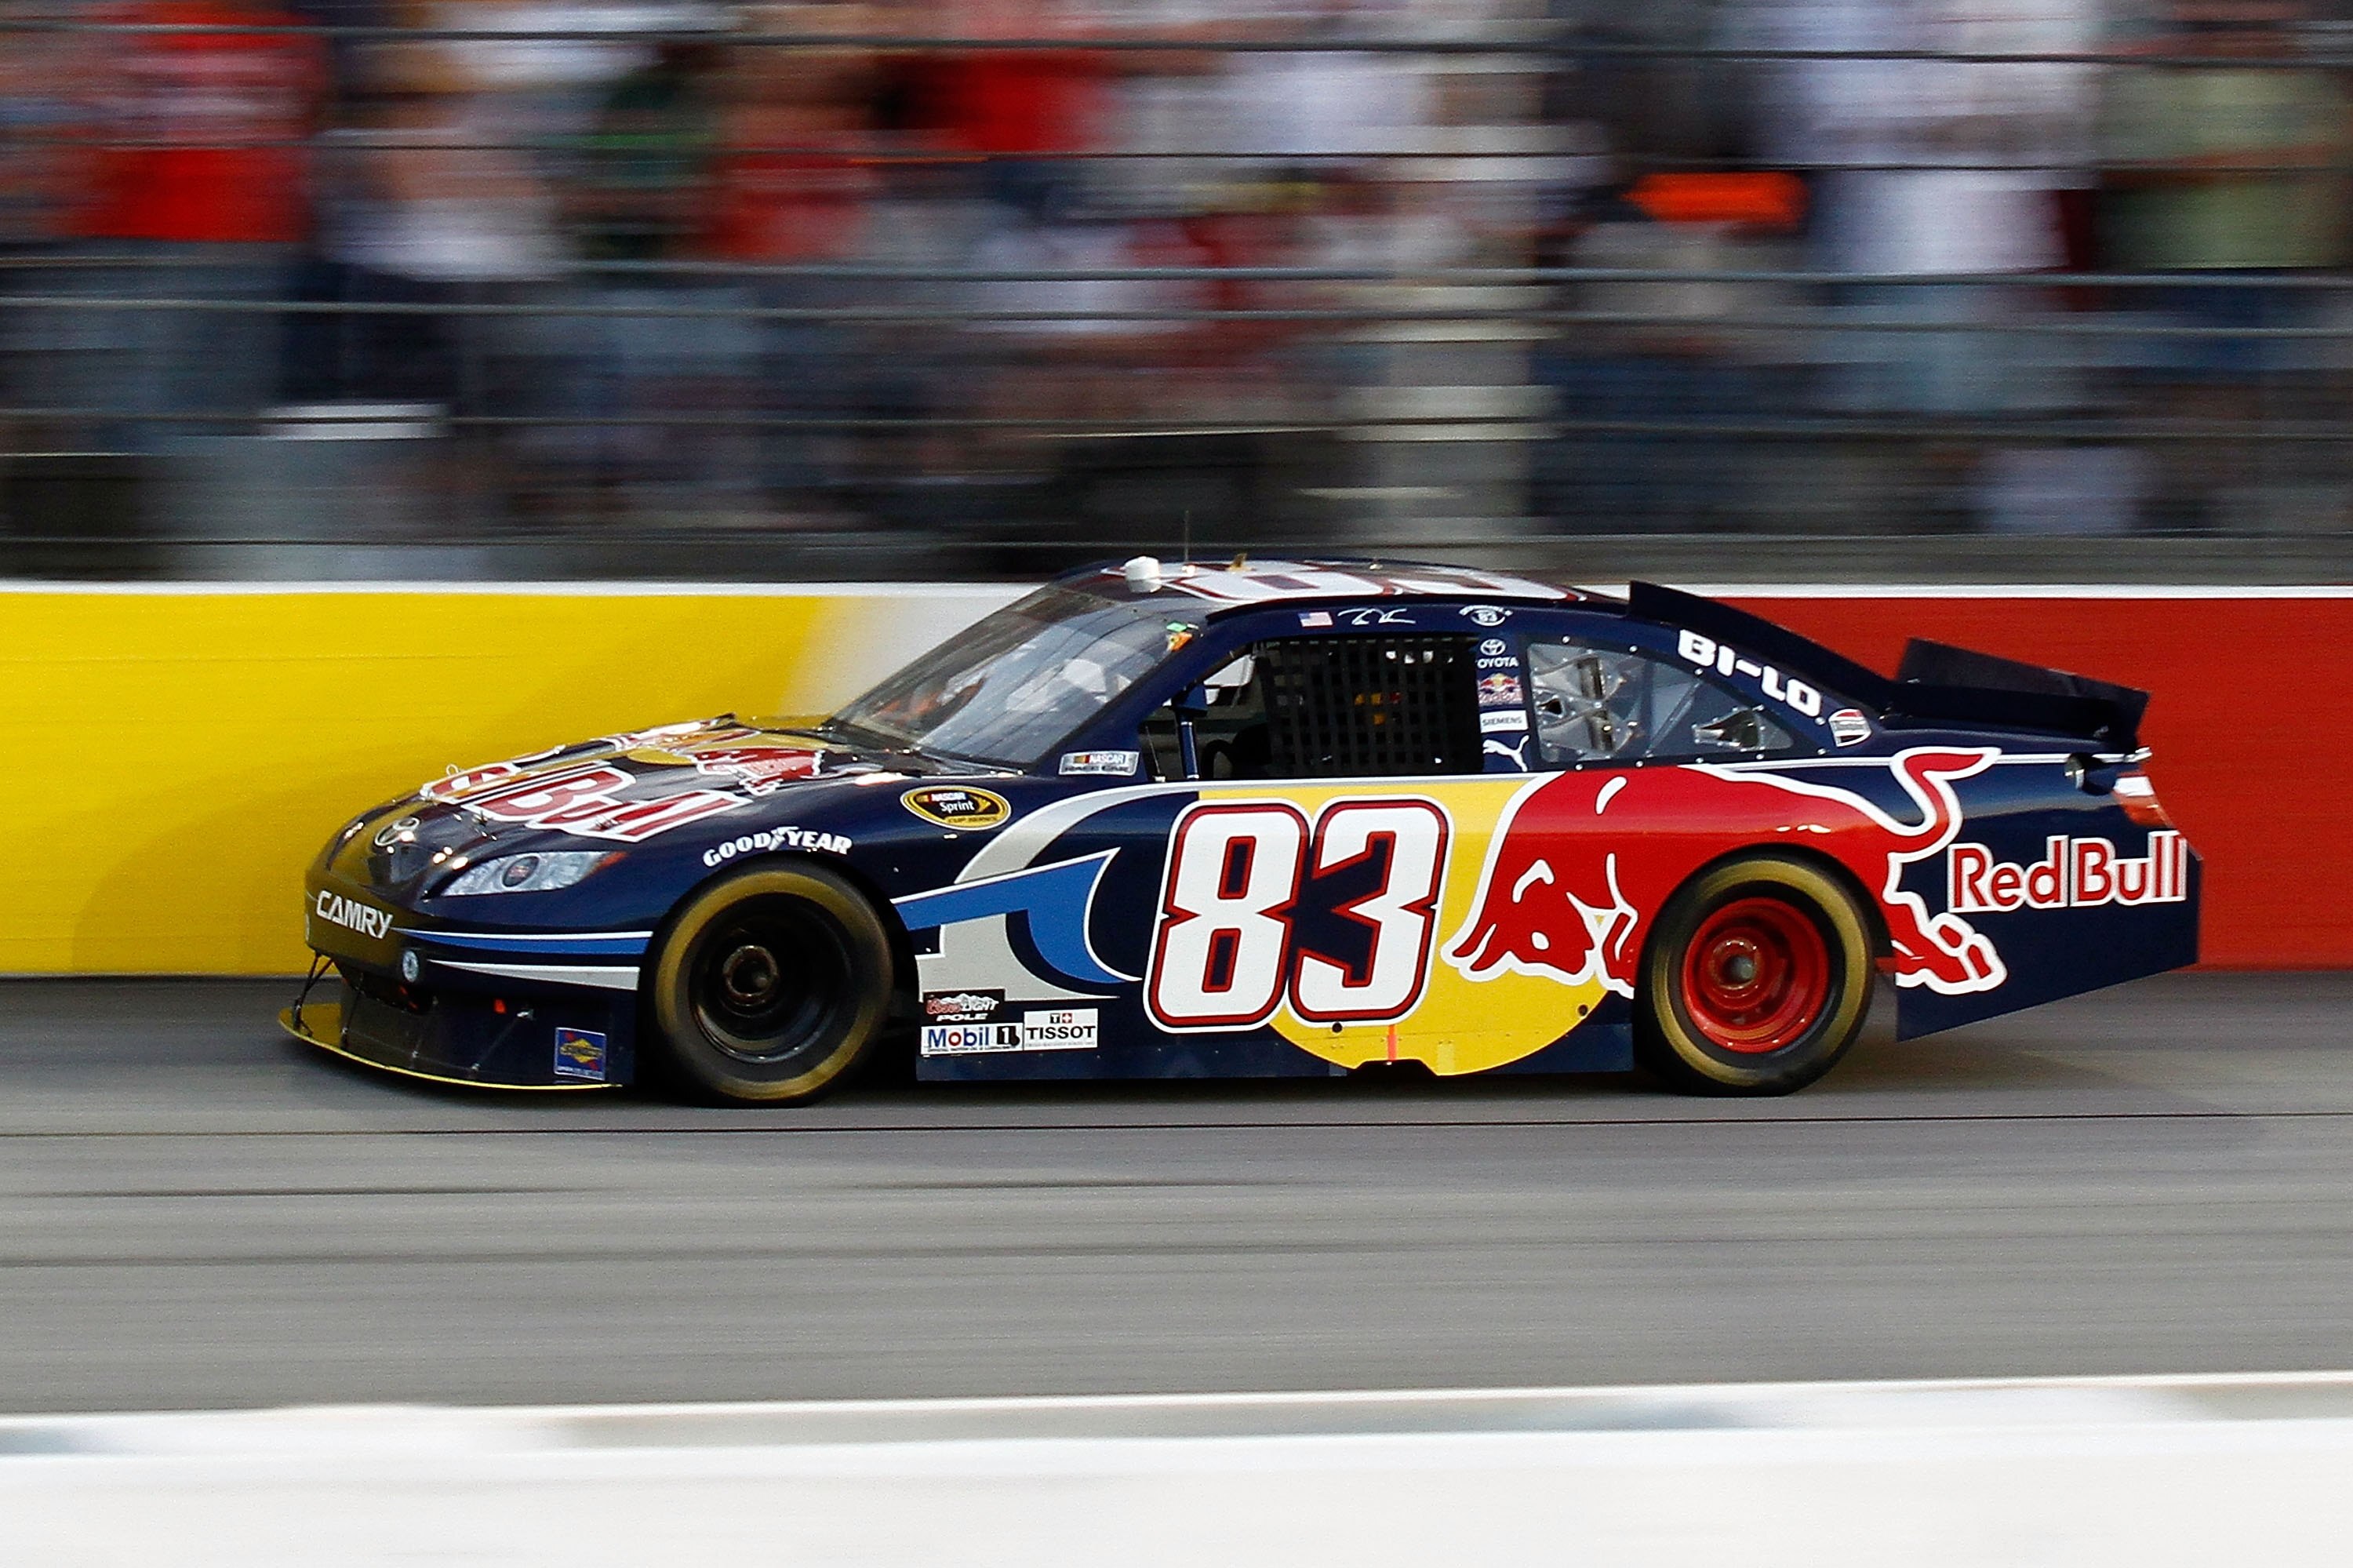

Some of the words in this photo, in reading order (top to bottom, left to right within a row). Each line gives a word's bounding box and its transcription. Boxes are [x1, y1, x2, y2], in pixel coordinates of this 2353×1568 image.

[1476, 657, 1519, 669] OYOTA
[1678, 630, 1821, 717] BI-LO
[1089, 754, 1125, 764] NASCAR
[939, 800, 975, 813] Sprint
[1948, 835, 2068, 912] Red
[2071, 830, 2187, 907] Bull
[316, 890, 393, 939] CAMRY
[1147, 799, 1449, 1029] 83
[936, 1013, 988, 1021] POLE
[928, 1027, 990, 1048] Mobil
[1025, 1025, 1096, 1040] TISSOT
